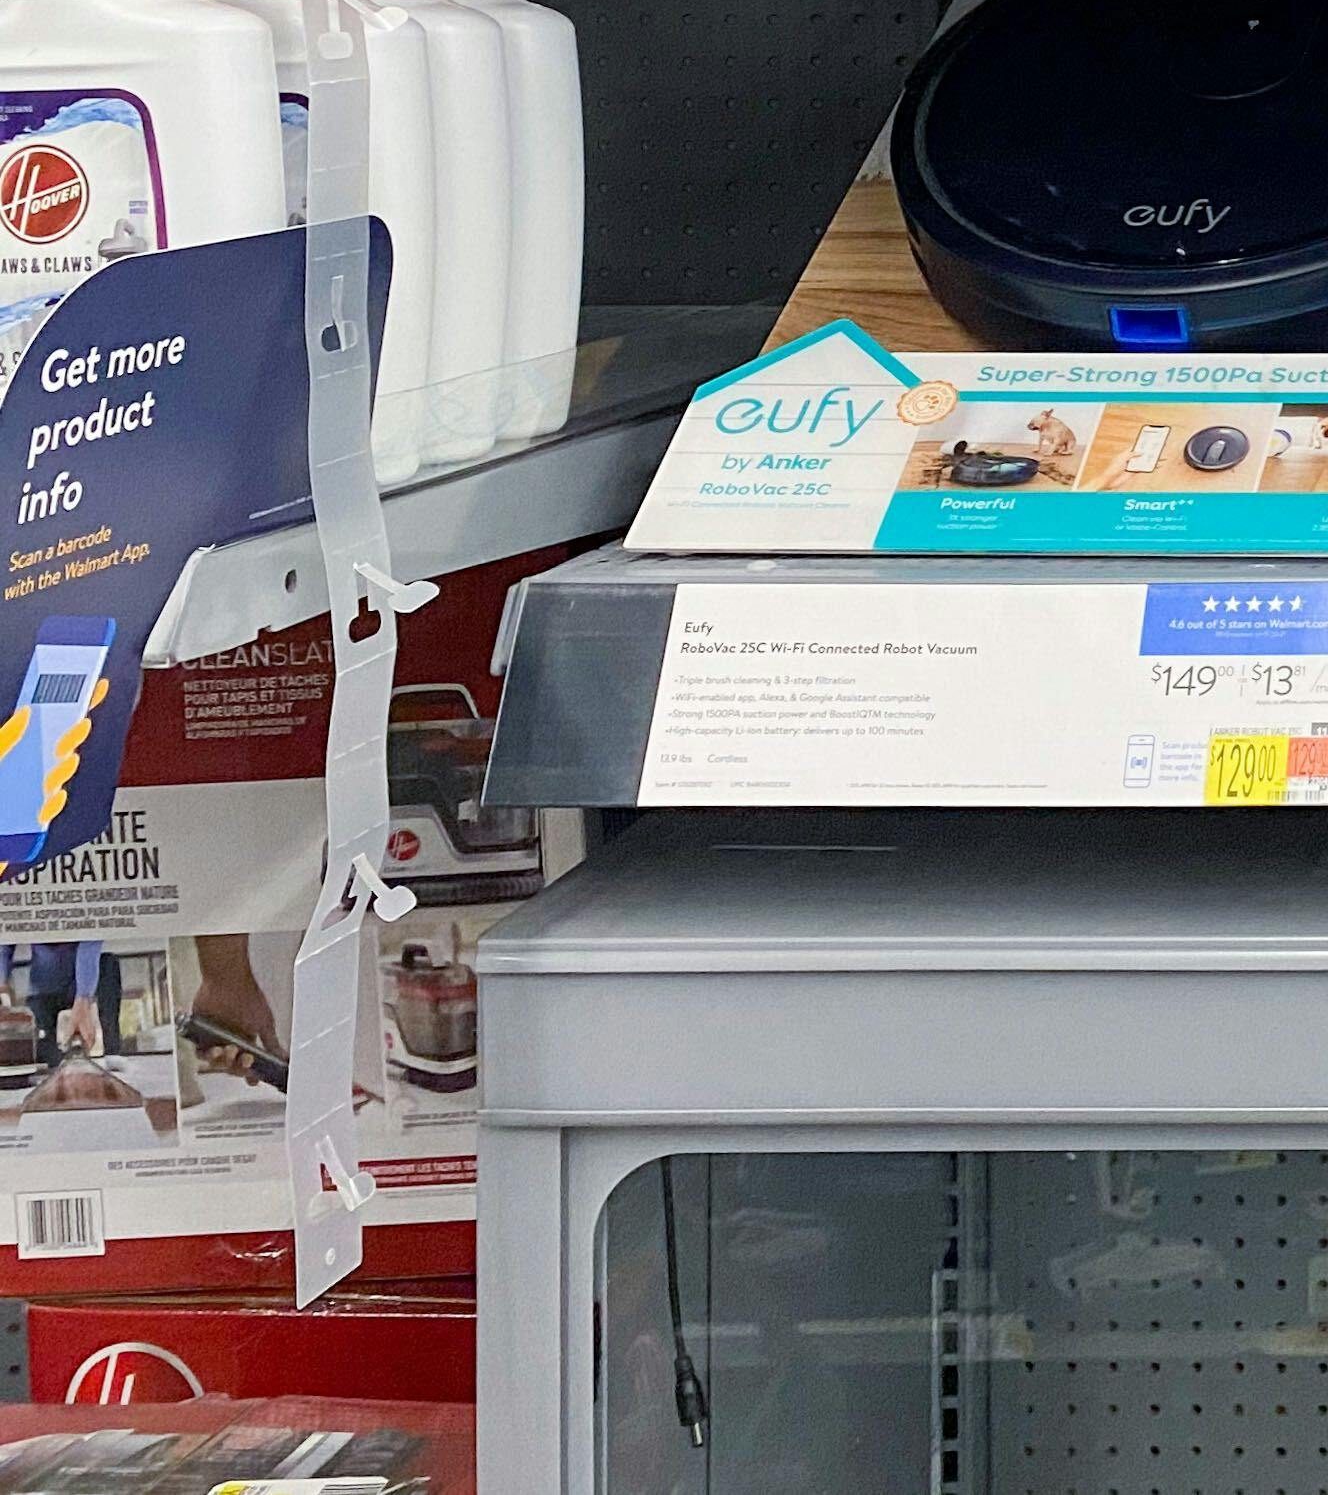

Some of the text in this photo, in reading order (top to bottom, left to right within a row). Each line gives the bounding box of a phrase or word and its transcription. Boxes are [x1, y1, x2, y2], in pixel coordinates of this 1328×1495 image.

[1124, 199, 1231, 233] eufy
[31, 258, 41, 273] &
[44, 257, 92, 273] CLAWS
[41, 335, 186, 393] Get more
[977, 367, 1157, 386] Super-Strong
[1166, 367, 1262, 382] 1500Pa
[27, 391, 155, 470] product
[715, 387, 884, 448] eufy
[722, 453, 832, 473] by Anker
[18, 471, 83, 525] info
[700, 483, 831, 495] RoboVac 25C
[941, 498, 1015, 509] Powerful
[9, 526, 111, 572] Scan a barcode
[4, 578, 35, 601] with
[38, 571, 61, 591] the
[64, 552, 120, 580] Walmart
[685, 622, 713, 635] Eufy
[681, 642, 976, 655] RoboVac 25C Wi-Fi Connected Robot Vacuum
